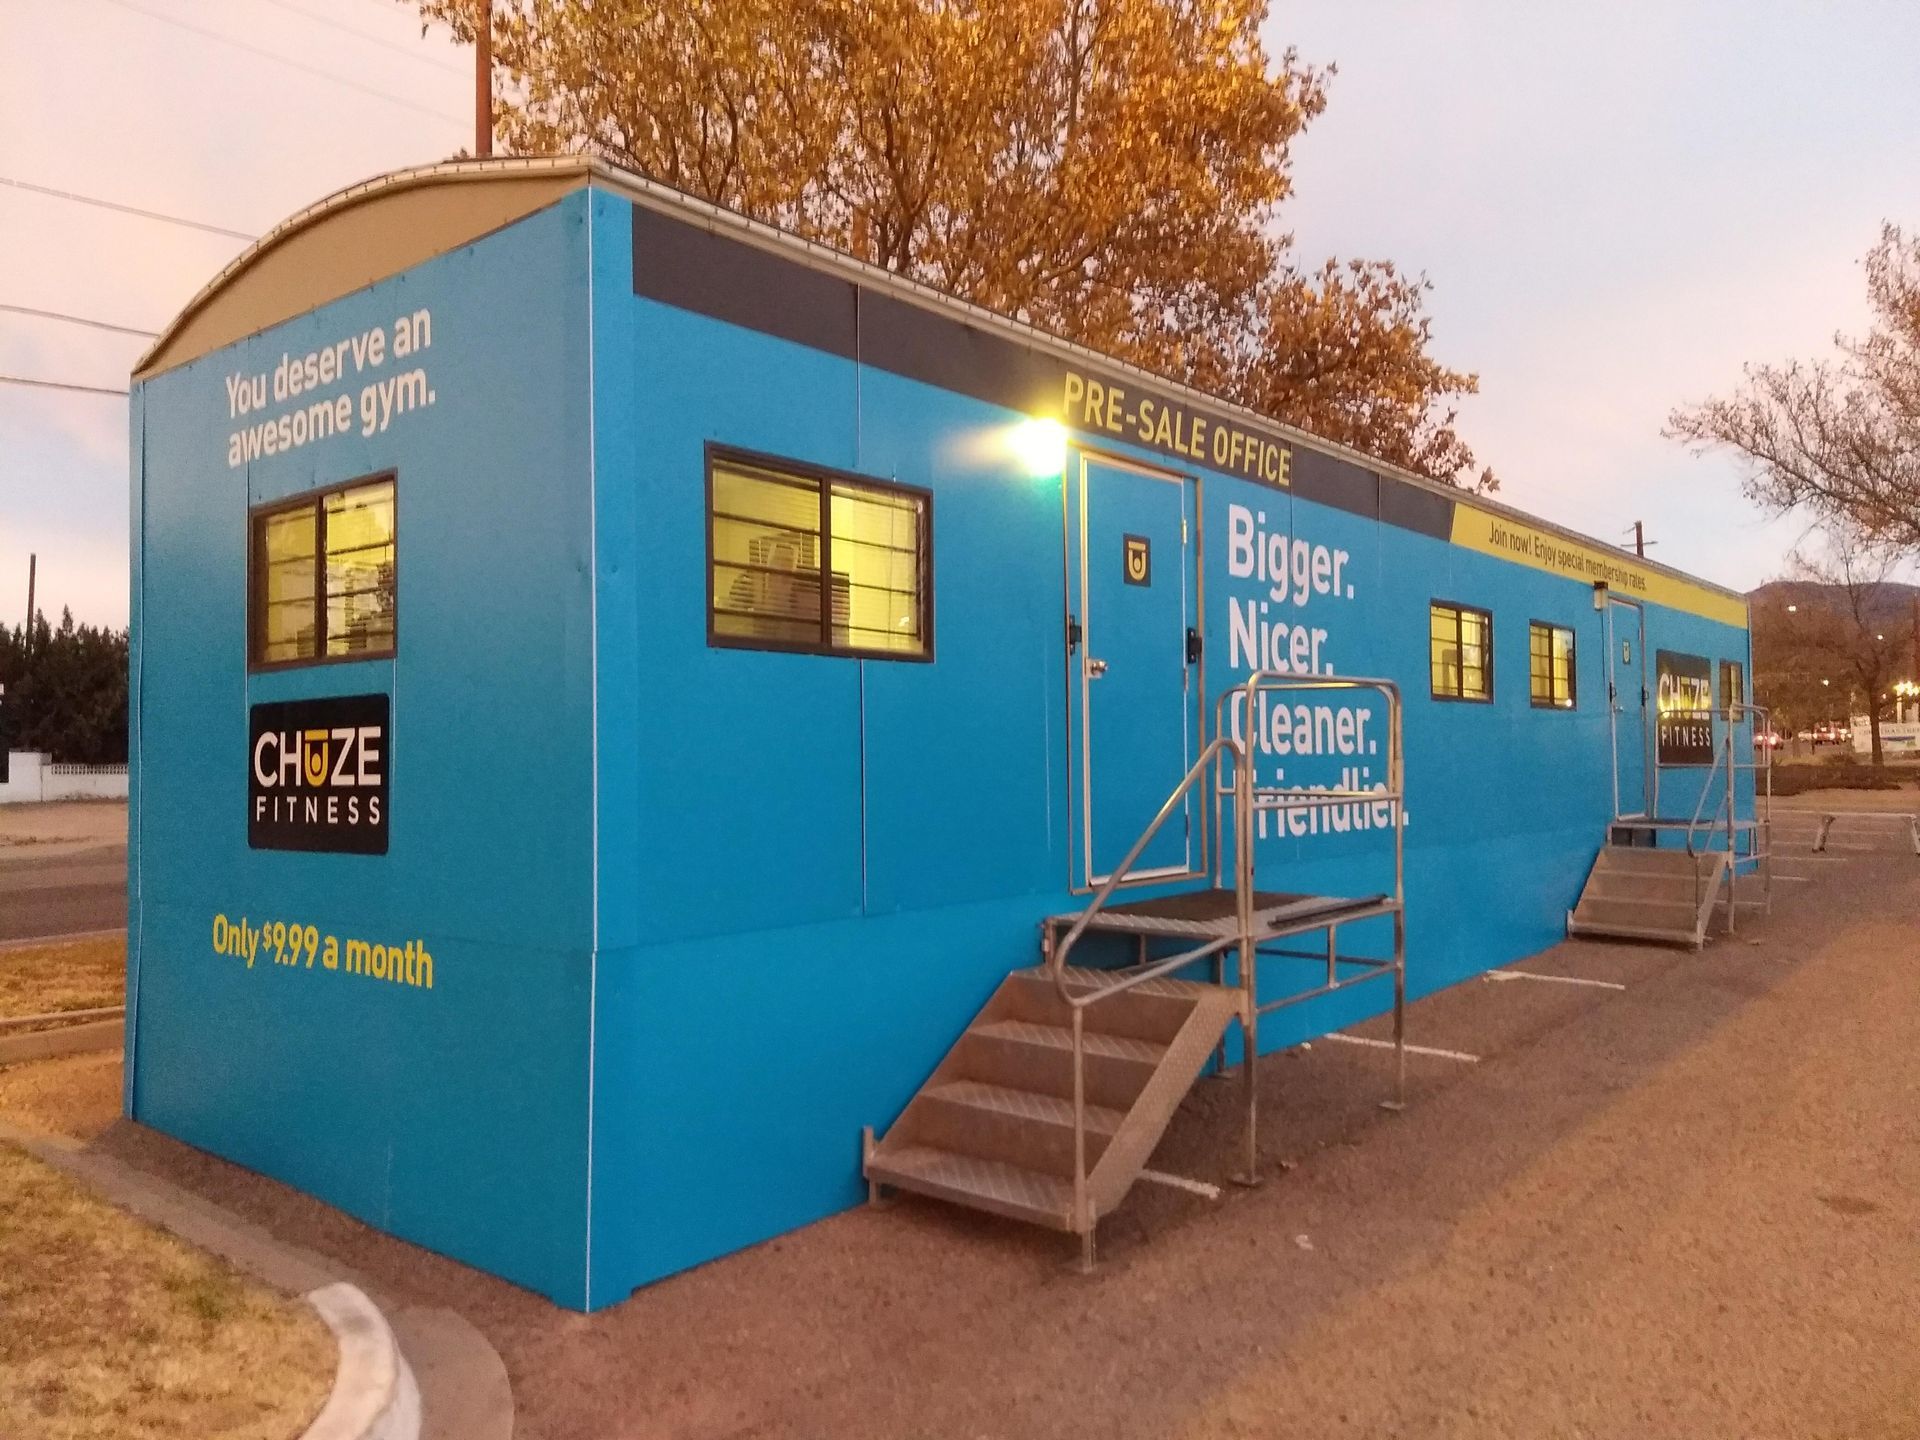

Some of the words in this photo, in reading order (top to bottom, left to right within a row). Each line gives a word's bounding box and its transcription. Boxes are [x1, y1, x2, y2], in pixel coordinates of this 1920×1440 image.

[226, 374, 267, 418] You
[274, 326, 384, 401] deserve
[394, 308, 431, 358] an
[228, 394, 351, 467] awesome
[360, 369, 436, 436] gym.
[1064, 372, 1206, 459] PRE-SALE
[1213, 427, 1292, 486] OFFICE
[1228, 504, 1354, 606] Bigger.
[1489, 522, 1507, 548] Join
[1510, 533, 1531, 556] now!
[1534, 535, 1556, 566] Enjoy
[1558, 552, 1584, 571] special
[1586, 559, 1628, 588] membership
[1230, 597, 1333, 675] Nicer.
[254, 726, 382, 788] CHUZE
[1231, 690, 1377, 755] Cleaner.
[1661, 726, 1711, 747] FITNESS
[256, 796, 380, 825] FITNESS
[1233, 767, 1409, 839] riendlie.
[213, 913, 259, 968] Only
[263, 921, 319, 968] $9.99
[322, 936, 338, 969] a
[346, 939, 433, 989] month
